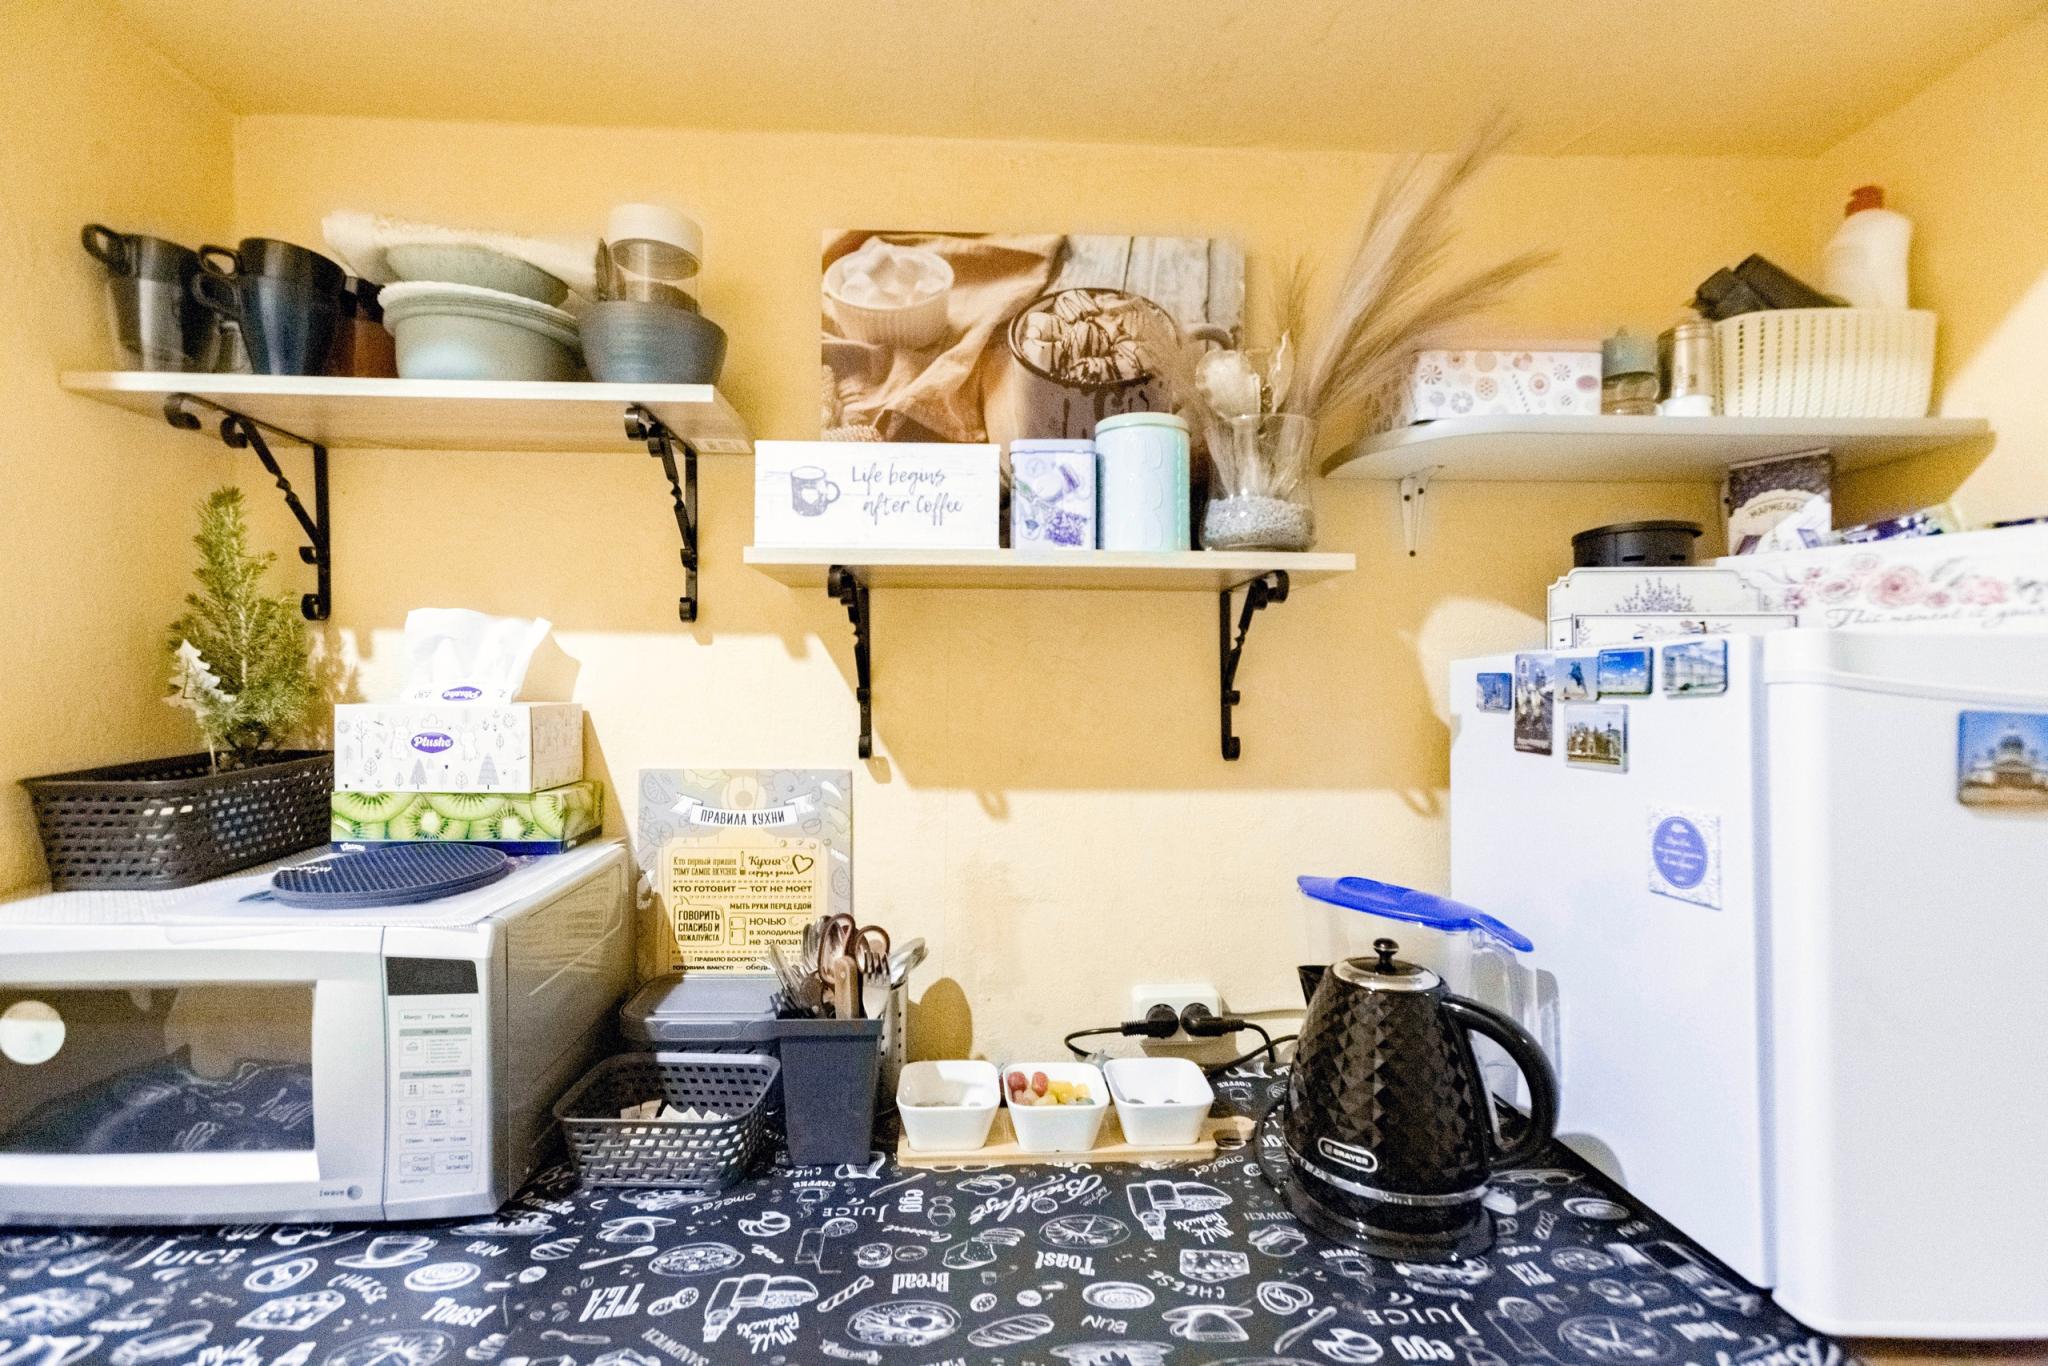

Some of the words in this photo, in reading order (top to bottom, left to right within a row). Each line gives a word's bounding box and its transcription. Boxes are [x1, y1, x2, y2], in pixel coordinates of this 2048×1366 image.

[851, 462, 882, 496] Life
[889, 462, 947, 495] begins
[863, 492, 910, 526] after
[413, 736, 452, 748] Plushe
[700, 809, 747, 826] ПРАВИЛА
[752, 810, 785, 825] КУХНИ
[673, 856, 686, 866] Кто
[748, 855, 782, 869] Кухня
[793, 902, 812, 910] ЕДОЙ
[678, 910, 721, 921] ГОВОРИТЬ
[749, 917, 787, 926] НОЧЬЮ
[678, 922, 713, 932] СПАСИБО
[715, 922, 720, 932] И
[678, 933, 720, 942] ПОЖАЛУЙСТА
[891, 1271, 951, 1295] Bread
[578, 1282, 646, 1323] TEA
